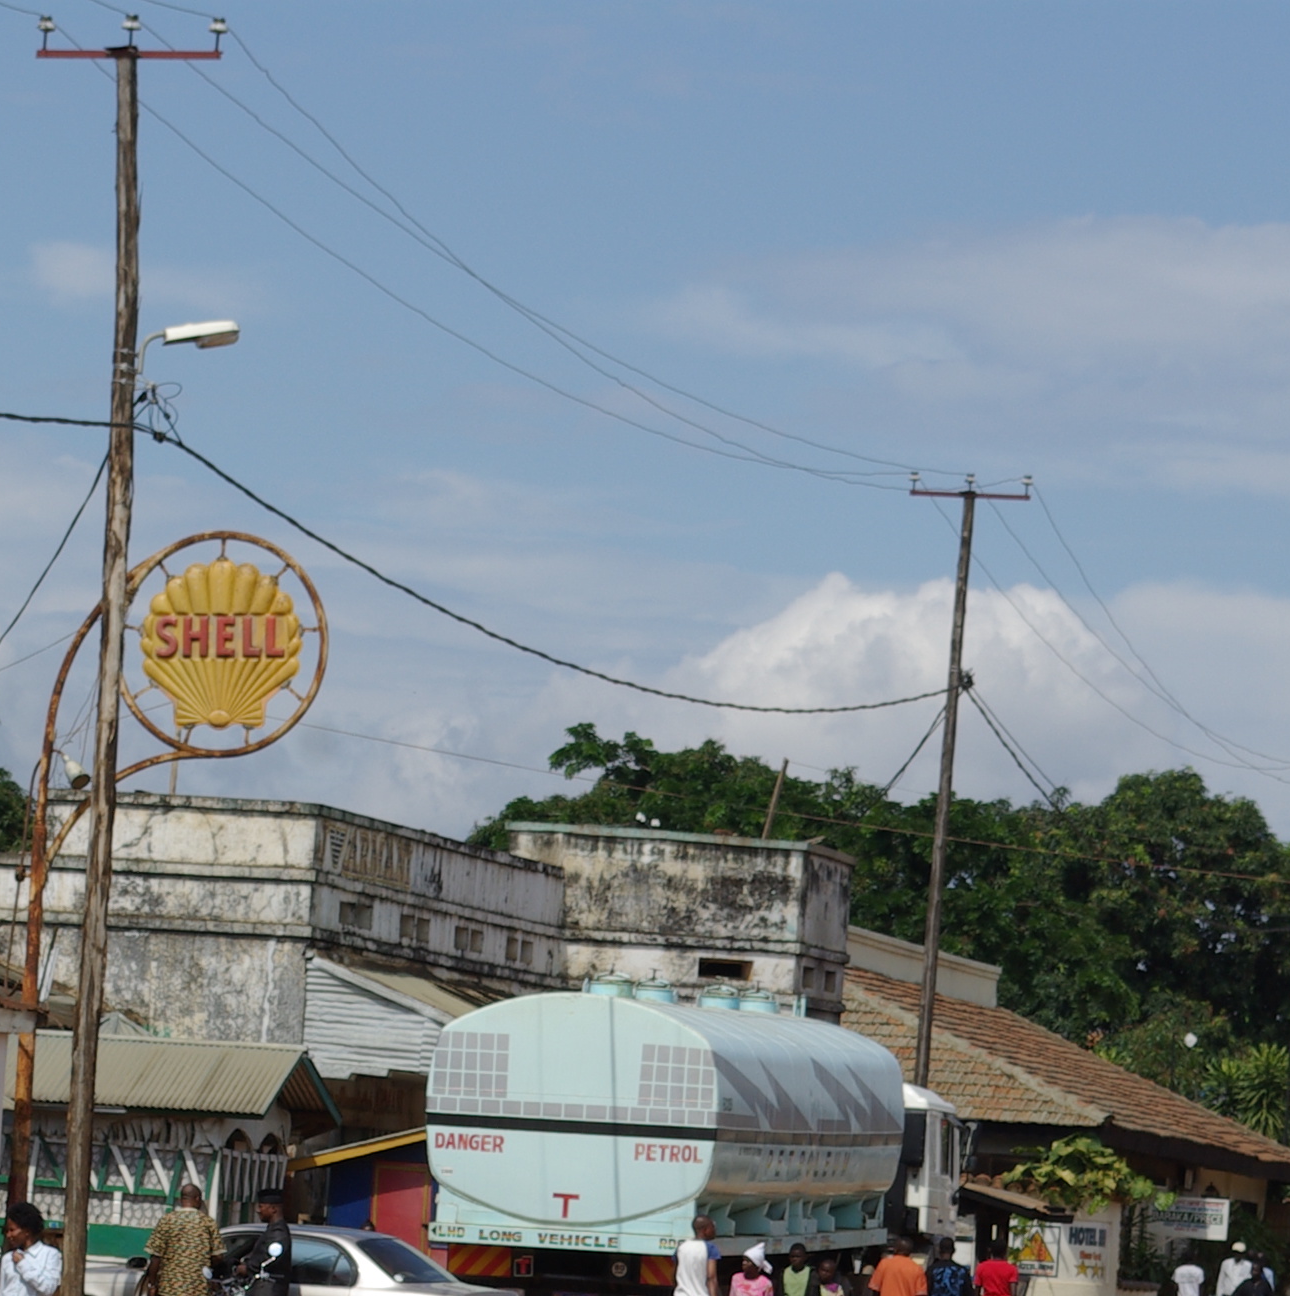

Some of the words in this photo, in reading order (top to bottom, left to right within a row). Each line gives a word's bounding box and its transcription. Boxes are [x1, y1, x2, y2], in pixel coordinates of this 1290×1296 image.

[155, 615, 285, 658] SHELL
[435, 1133, 504, 1153] DANGER
[634, 1143, 703, 1163] PETROL
[553, 1193, 579, 1218] T
[478, 1229, 522, 1243] LONG
[537, 1232, 620, 1249] VEHICLE
[1069, 1226, 1097, 1246] HOTEL
